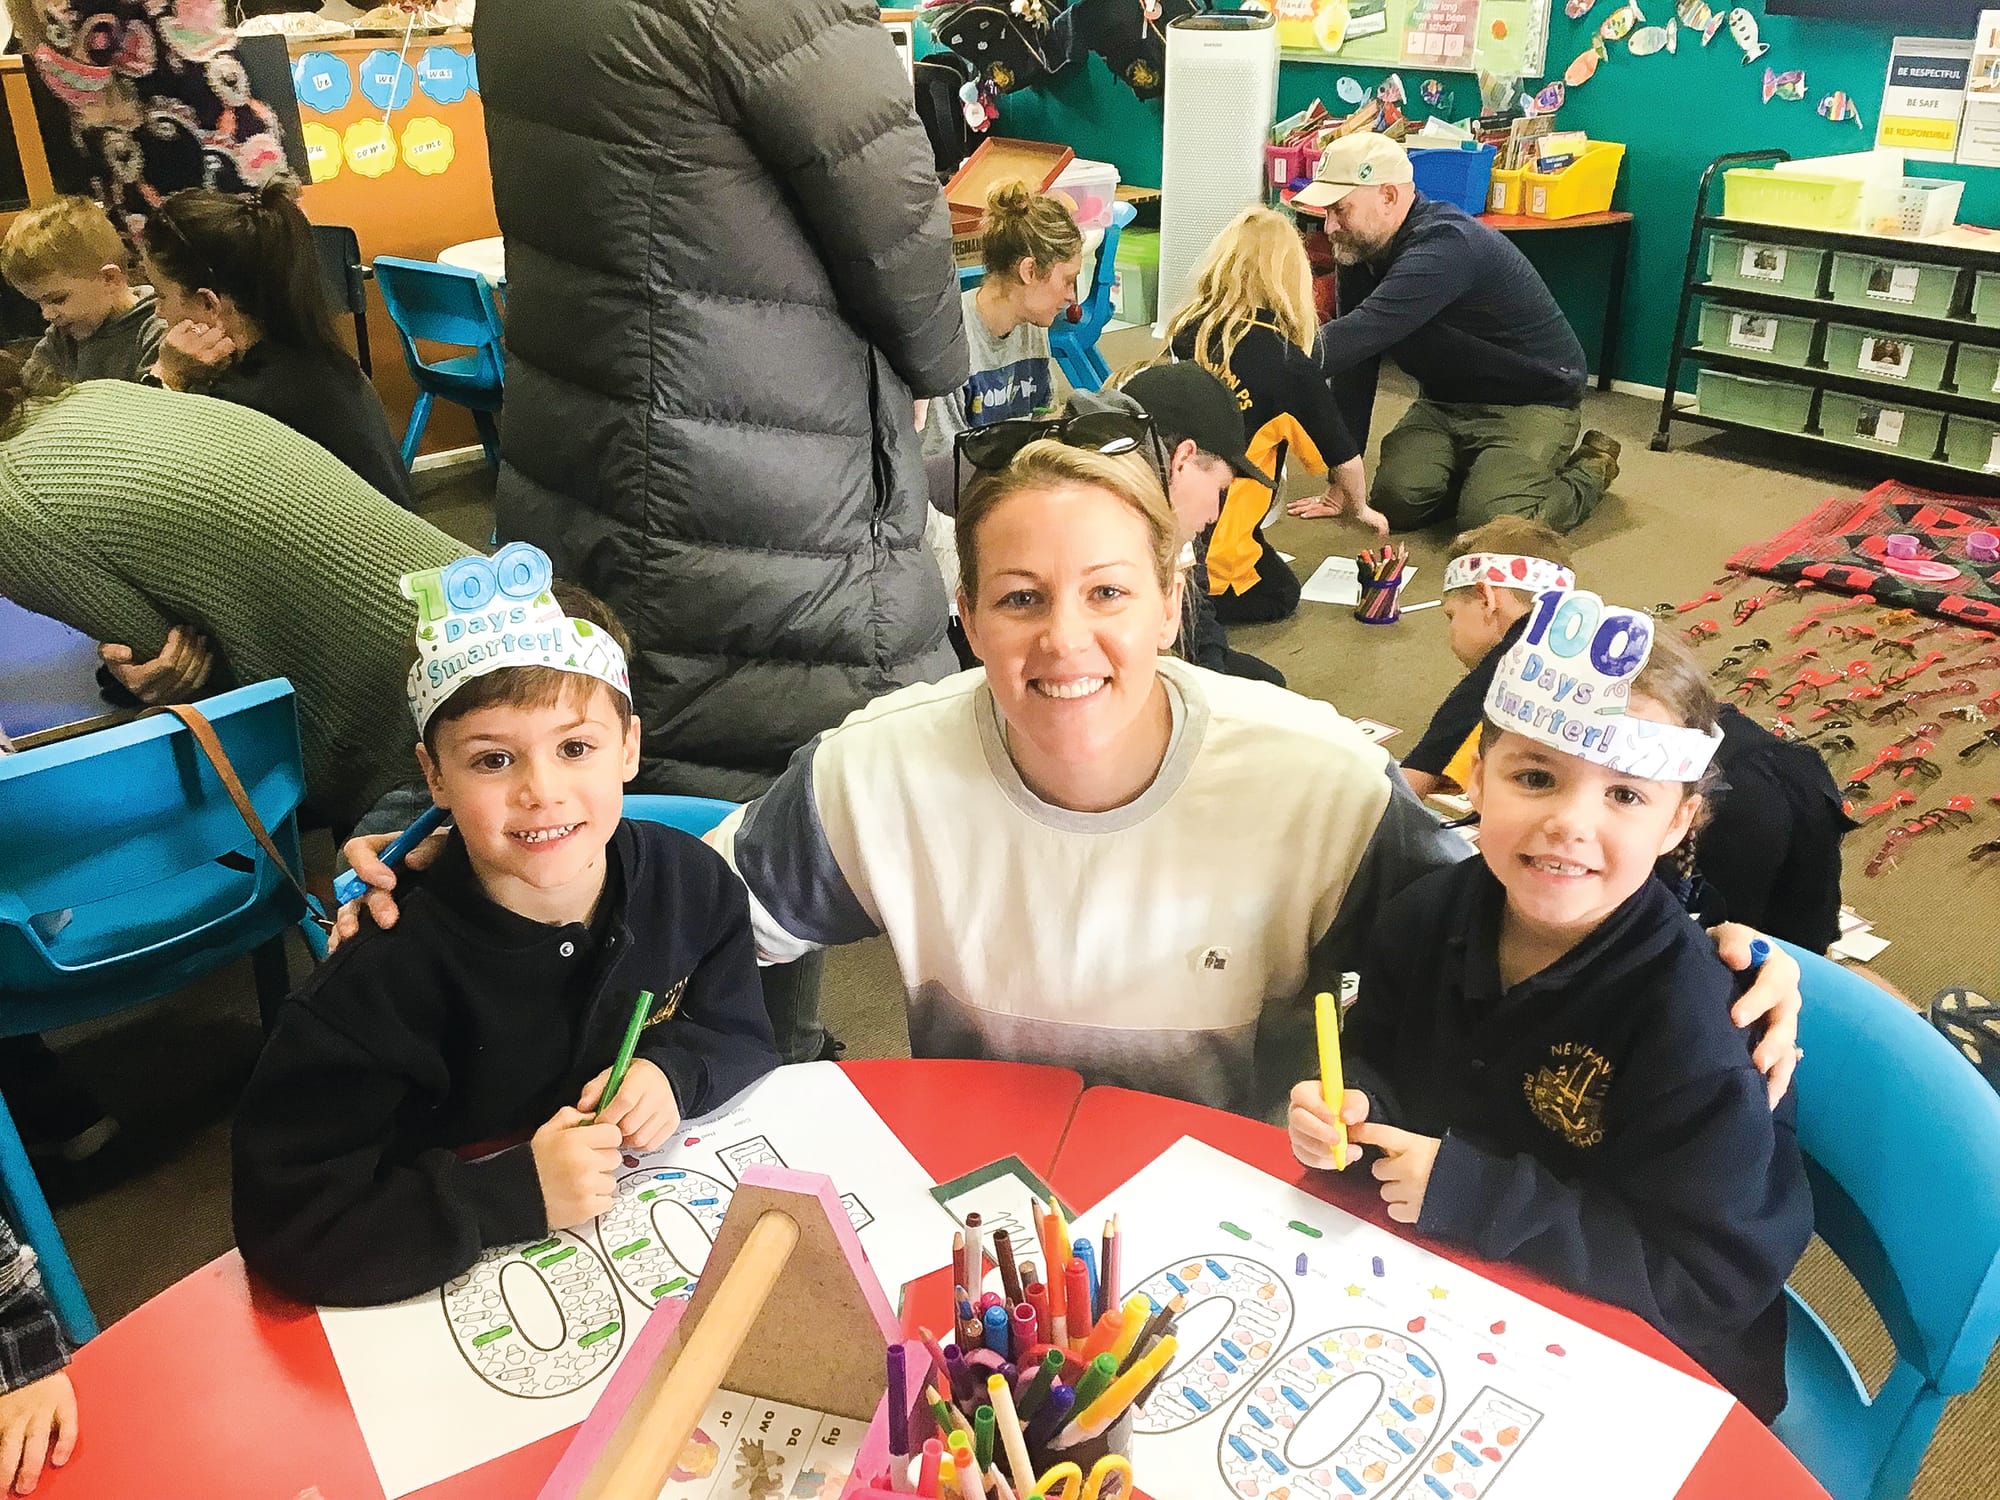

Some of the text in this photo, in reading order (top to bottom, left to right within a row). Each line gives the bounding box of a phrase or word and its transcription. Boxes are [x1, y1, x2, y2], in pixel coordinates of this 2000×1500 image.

[1440, 1, 1458, 13] long
[1446, 12, 1466, 22] been
[1429, 22, 1457, 32] school?
[377, 75, 394, 83] we
[428, 70, 452, 78] was
[1897, 66, 1961, 79] BE RESPECTFUL
[316, 75, 330, 89] be
[1906, 98, 1939, 108] BE SAFE
[1884, 127, 1951, 140] BE RESPONSIBLE
[308, 145, 324, 154] ou
[356, 143, 387, 159] come
[413, 140, 442, 155] some
[1235, 388, 1254, 411] PS
[411, 548, 547, 622] 100
[445, 607, 527, 643] Days
[1526, 591, 1650, 678] 100
[427, 628, 564, 689] Smarter!
[1520, 653, 1595, 705] Days
[1495, 680, 1618, 753] Smarter!
[719, 1410, 732, 1428] or
[759, 1410, 775, 1433] ow
[786, 1427, 802, 1447] oa
[821, 1427, 841, 1446] ay
